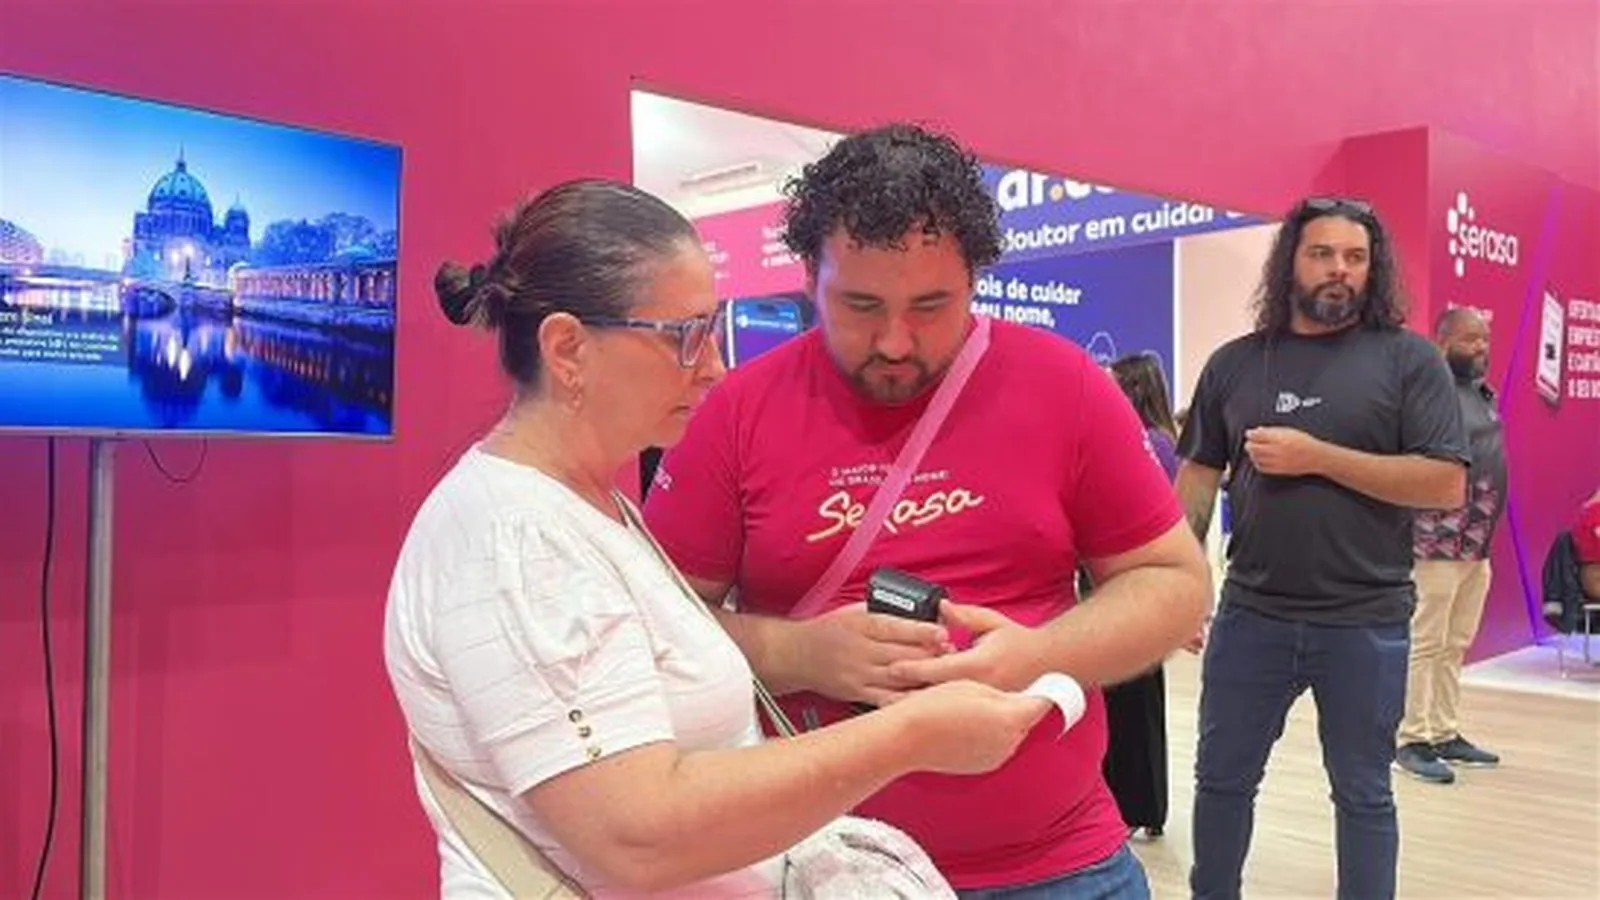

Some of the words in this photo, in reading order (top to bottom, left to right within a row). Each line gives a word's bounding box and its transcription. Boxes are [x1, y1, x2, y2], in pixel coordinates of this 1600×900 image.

[1085, 220, 1126, 239] em
[1131, 203, 1214, 233] cuidar
[1458, 223, 1519, 266] serasa
[976, 276, 1004, 298] ois
[1006, 278, 1028, 299] de
[1031, 280, 1082, 305] cuidar
